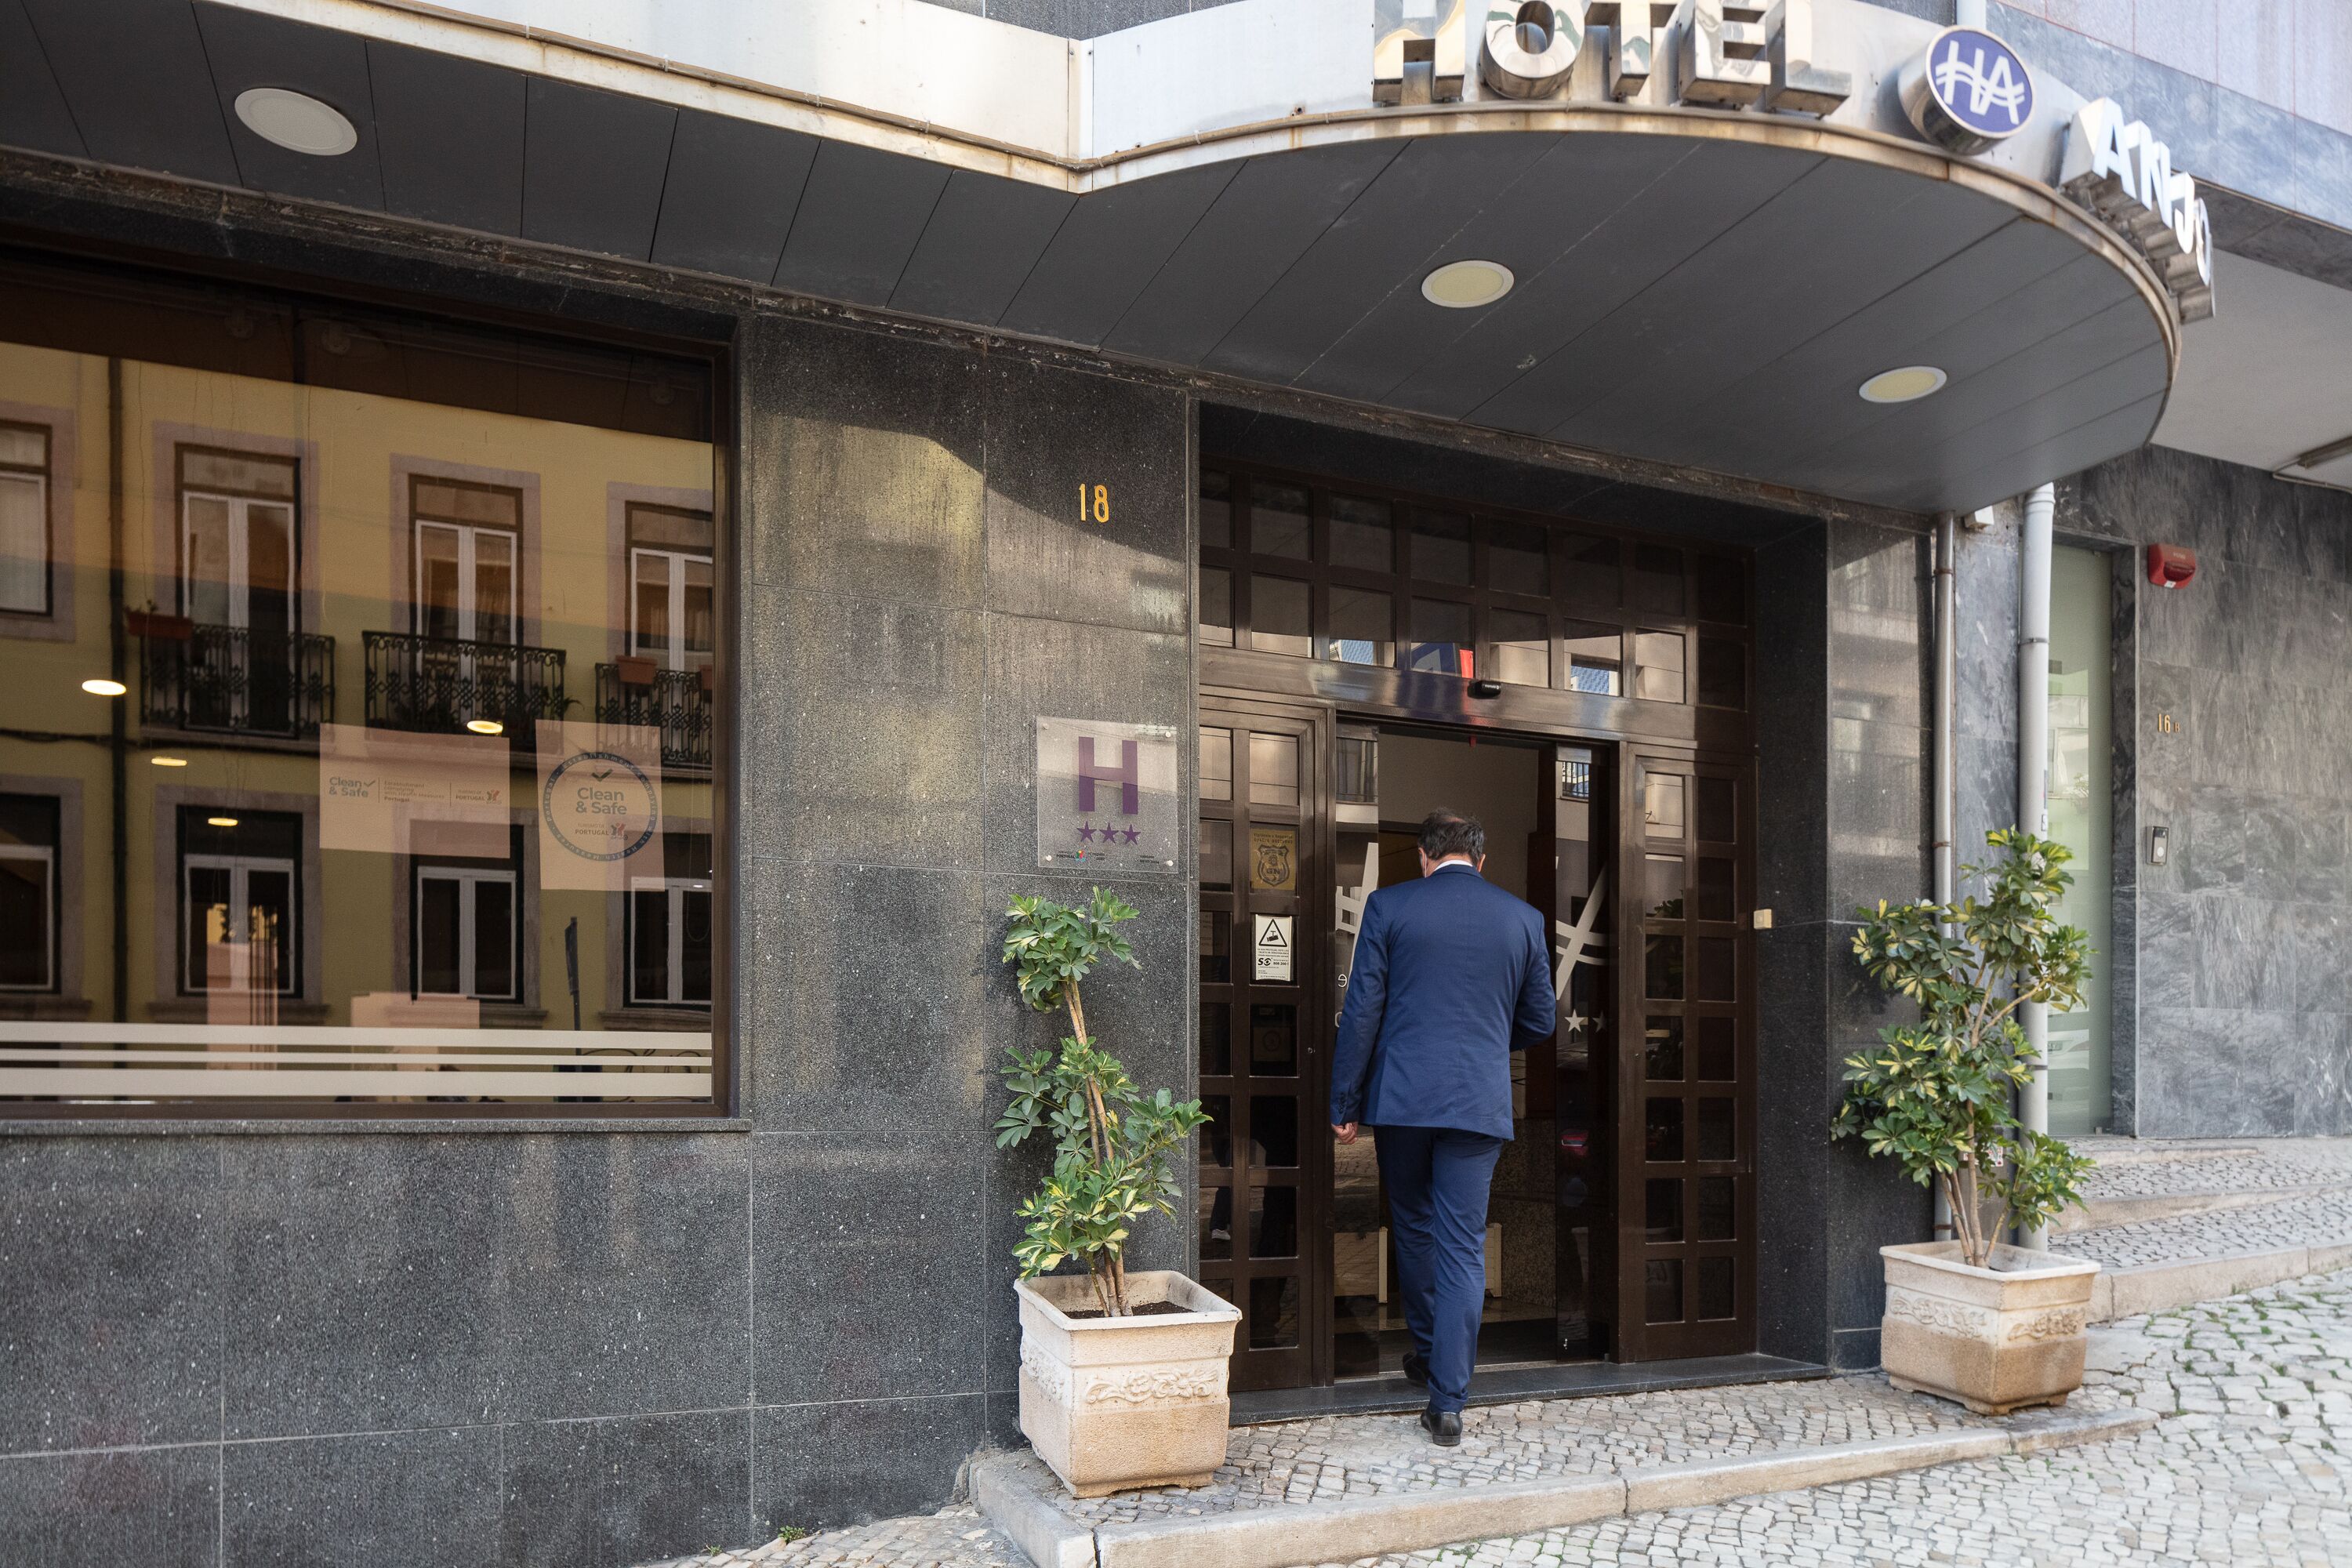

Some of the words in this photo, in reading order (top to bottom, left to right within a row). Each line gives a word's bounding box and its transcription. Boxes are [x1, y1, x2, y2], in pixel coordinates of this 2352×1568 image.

[1373, 0, 1852, 114] HOTEL
[1079, 483, 1109, 524] 18
[2158, 713, 2171, 734] 16
[329, 776, 361, 788] Clean
[1078, 735, 1139, 815] H
[329, 786, 337, 796] &
[341, 786, 368, 798] Safe
[577, 786, 624, 801] Clean
[575, 801, 587, 815] &
[591, 801, 627, 815] Safe
